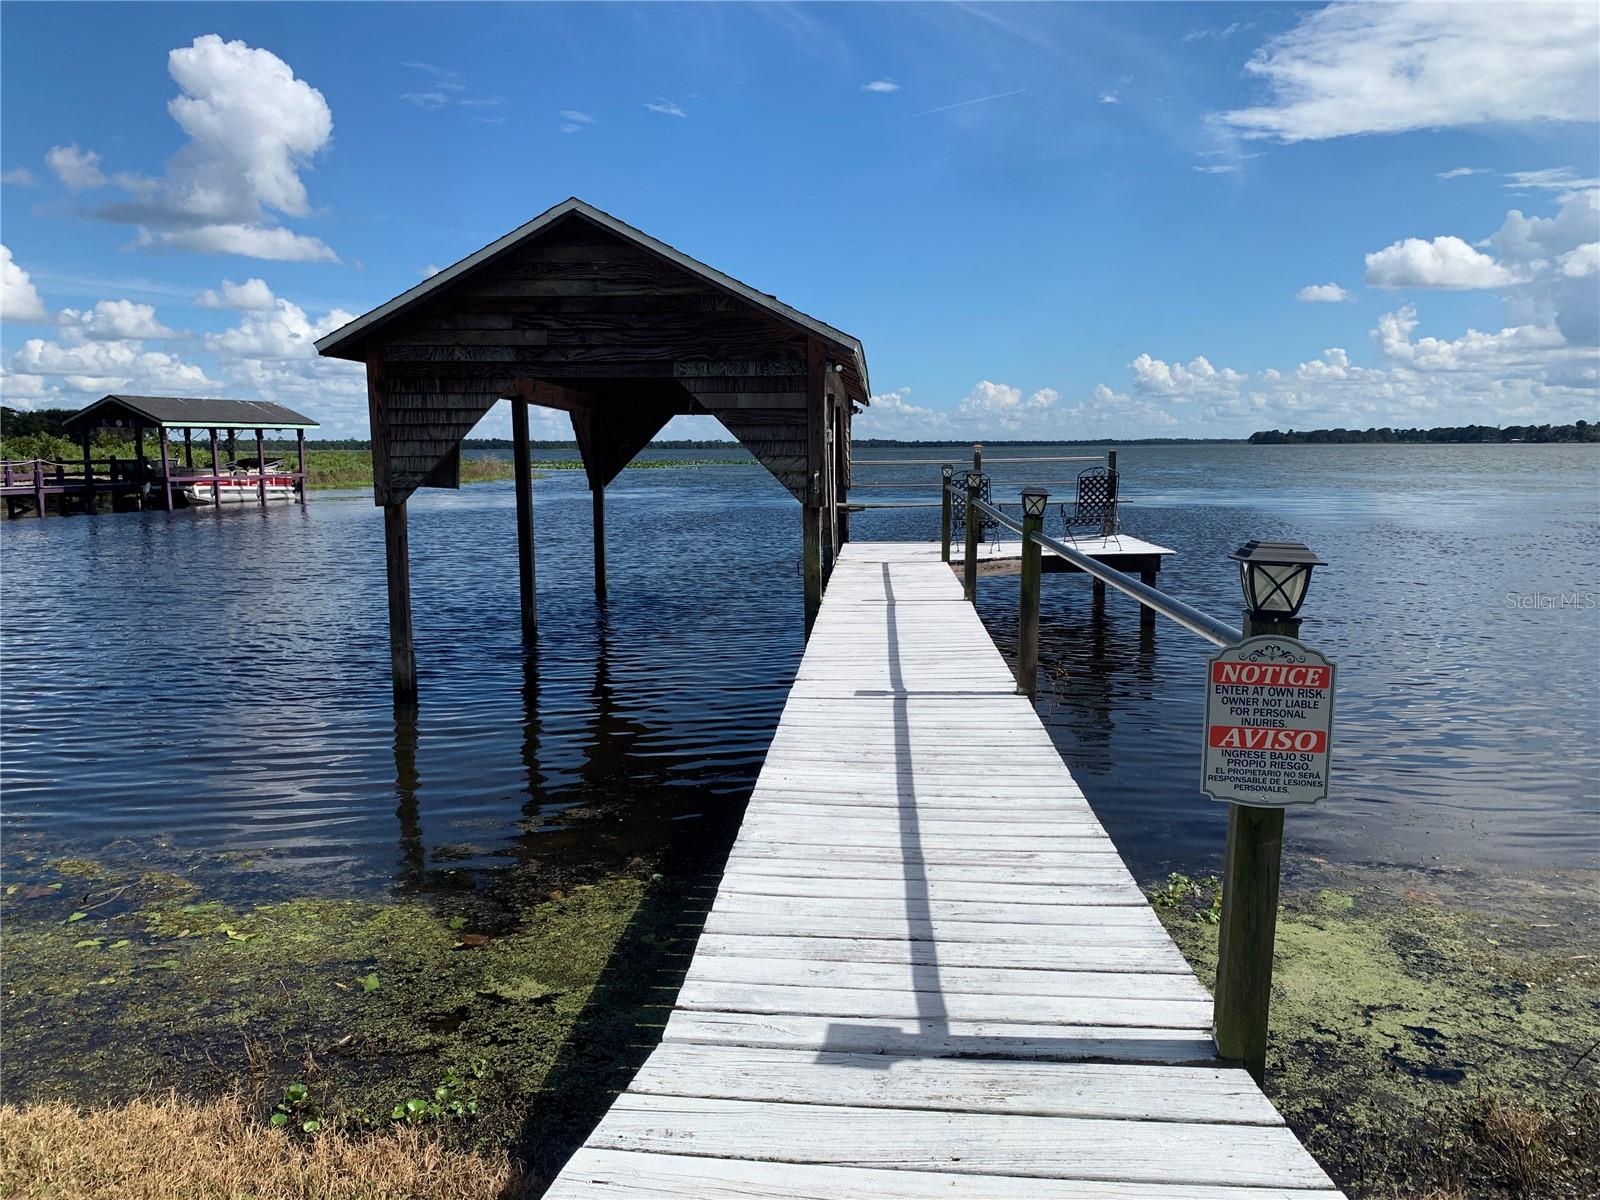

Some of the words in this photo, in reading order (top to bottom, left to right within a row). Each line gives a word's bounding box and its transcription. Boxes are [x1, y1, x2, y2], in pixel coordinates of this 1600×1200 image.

[1220, 664, 1323, 686] NOTICE
[1215, 685, 1250, 695] ENTER
[1252, 686, 1264, 696] AT
[1268, 688, 1294, 698] OWN
[1298, 689, 1326, 700] RISK.
[1222, 696, 1260, 706] OWNER
[1262, 698, 1282, 708] NOT
[1286, 700, 1319, 710] LIABLE
[1230, 707, 1250, 716] FOR
[1253, 708, 1306, 719] PERSONAL
[1241, 718, 1288, 728] INJURIES.
[1218, 728, 1318, 751] AVISO
[1221, 749, 1266, 760] INGRESE
[1270, 752, 1296, 761] BAJO
[1300, 753, 1314, 762] SU
[1227, 758, 1266, 768] PROPIO
[1270, 761, 1312, 771] RIESGO.
[1228, 768, 1282, 778] PROPIETARIO
[1298, 771, 1320, 780] SERÁ
[1208, 775, 1266, 786] RESPONSABLE
[1283, 779, 1324, 788] LESIONES
[1234, 784, 1290, 794] PERSONALES.
